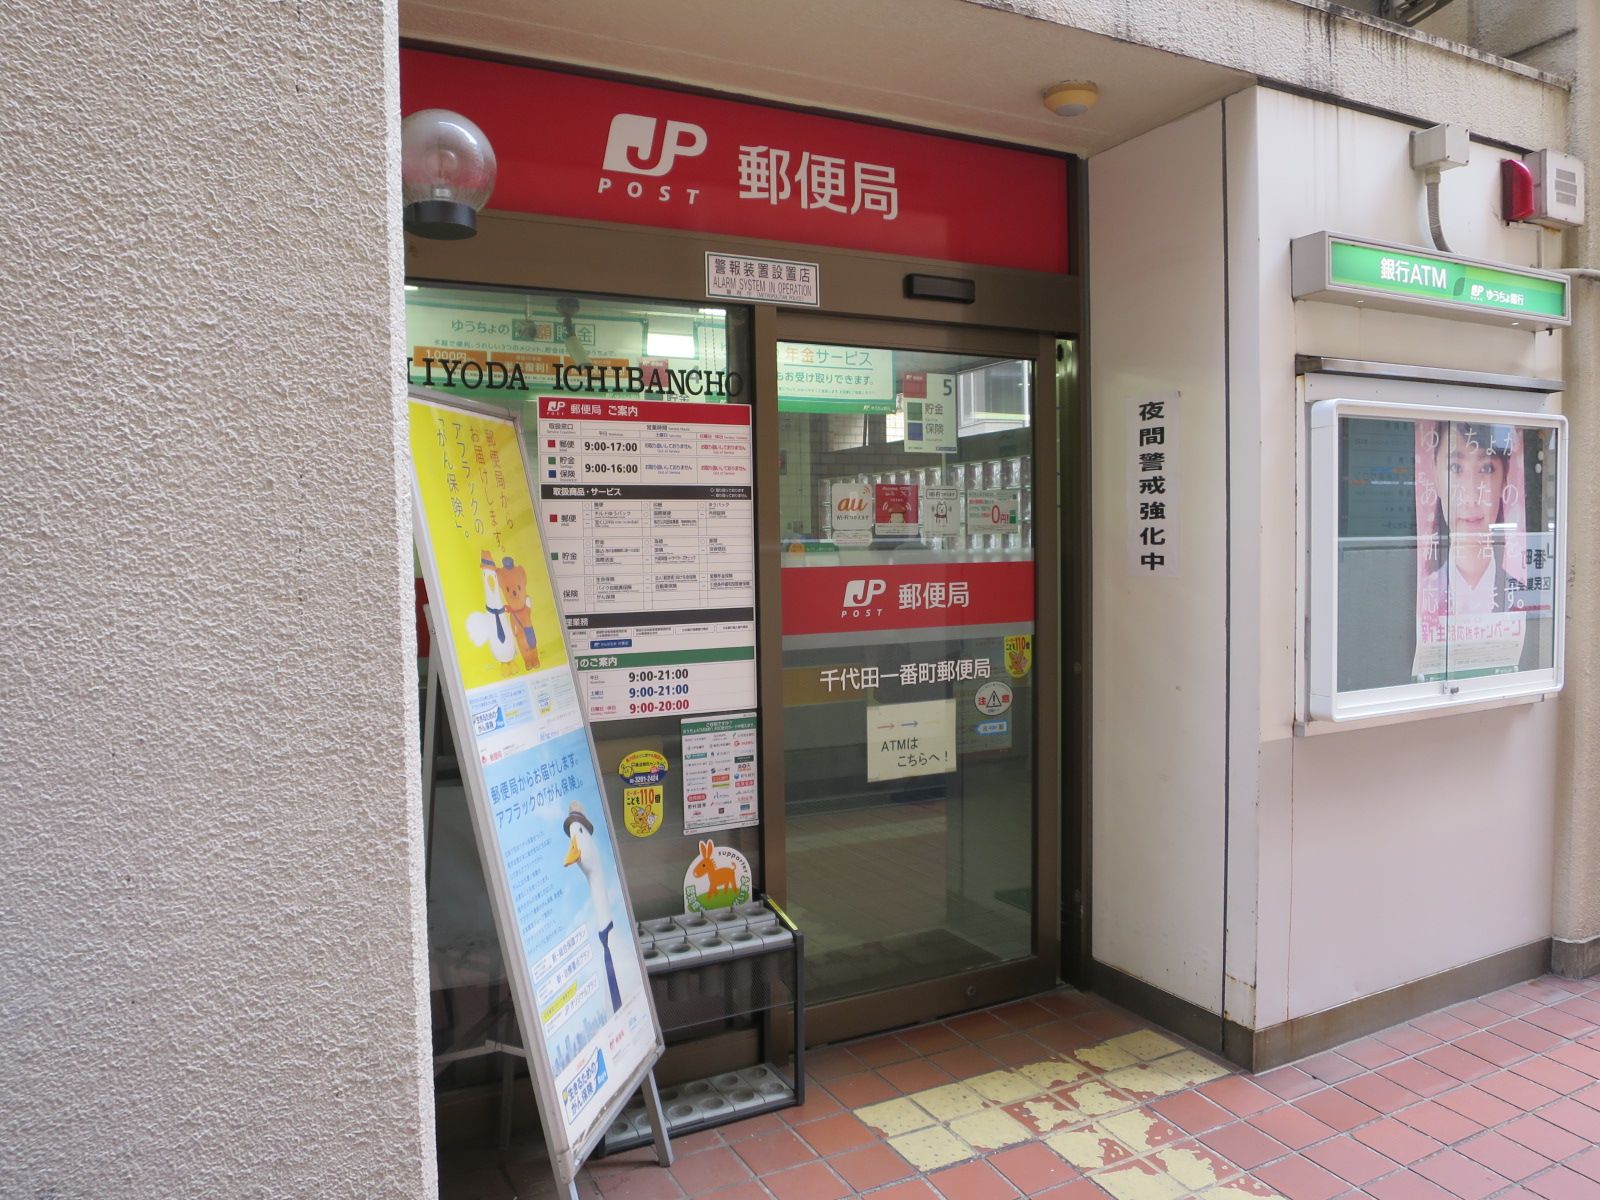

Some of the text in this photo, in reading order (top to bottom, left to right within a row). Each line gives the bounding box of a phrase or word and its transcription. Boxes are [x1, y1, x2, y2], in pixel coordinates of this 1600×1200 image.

[738, 145, 898, 220] 郵便局
[597, 177, 700, 205] POST
[714, 258, 810, 283] 警報装置設置店
[713, 276, 736, 290] ALARM
[740, 279, 766, 292] SYSTEM
[769, 281, 776, 292] IN
[778, 282, 812, 297] OPERATION
[1380, 257, 1447, 289] 銀行ATM
[1486, 290, 1524, 306] ゆうちょ銀行
[452, 319, 510, 335] ゆうちょの
[785, 347, 873, 366] 年金サービス
[553, 364, 743, 397] ICHIBANCHO
[944, 378, 952, 396] 5
[570, 403, 601, 415] 郵便局
[608, 405, 638, 417] ご案内
[925, 403, 944, 415] 貯金
[925, 423, 944, 435] 保険
[560, 440, 575, 448] 郵便
[584, 441, 638, 452] 9:00-17:00
[560, 456, 575, 465] 貯金
[585, 463, 638, 474] 9:00-16:00
[452, 422, 485, 535] アフラックの
[485, 427, 514, 529] 郵便局から
[560, 470, 575, 478] 保険
[470, 425, 506, 553] お届けします。
[552, 487, 622, 496] 取扱商品・サービス
[1138, 401, 1166, 571] 夜間警戒強化中
[837, 496, 869, 512] au
[561, 514, 577, 523] 郵便
[562, 552, 577, 560] 貯金
[563, 589, 579, 598] 保険
[843, 579, 970, 611] JP 郵便局
[841, 608, 883, 618] POST
[628, 668, 689, 683] 9:00-21:00
[819, 658, 991, 692] 千代田一番町郵便局
[628, 683, 689, 699] 9:00-21:00
[629, 699, 690, 714] 9:00-20:00
[881, 737, 919, 752] ATMは
[490, 753, 579, 805] 郵便局からお届けします。
[496, 775, 584, 829] アフラックの「がん保険」。
[718, 850, 748, 873] supporter
[571, 1082, 594, 1116] がん保険
